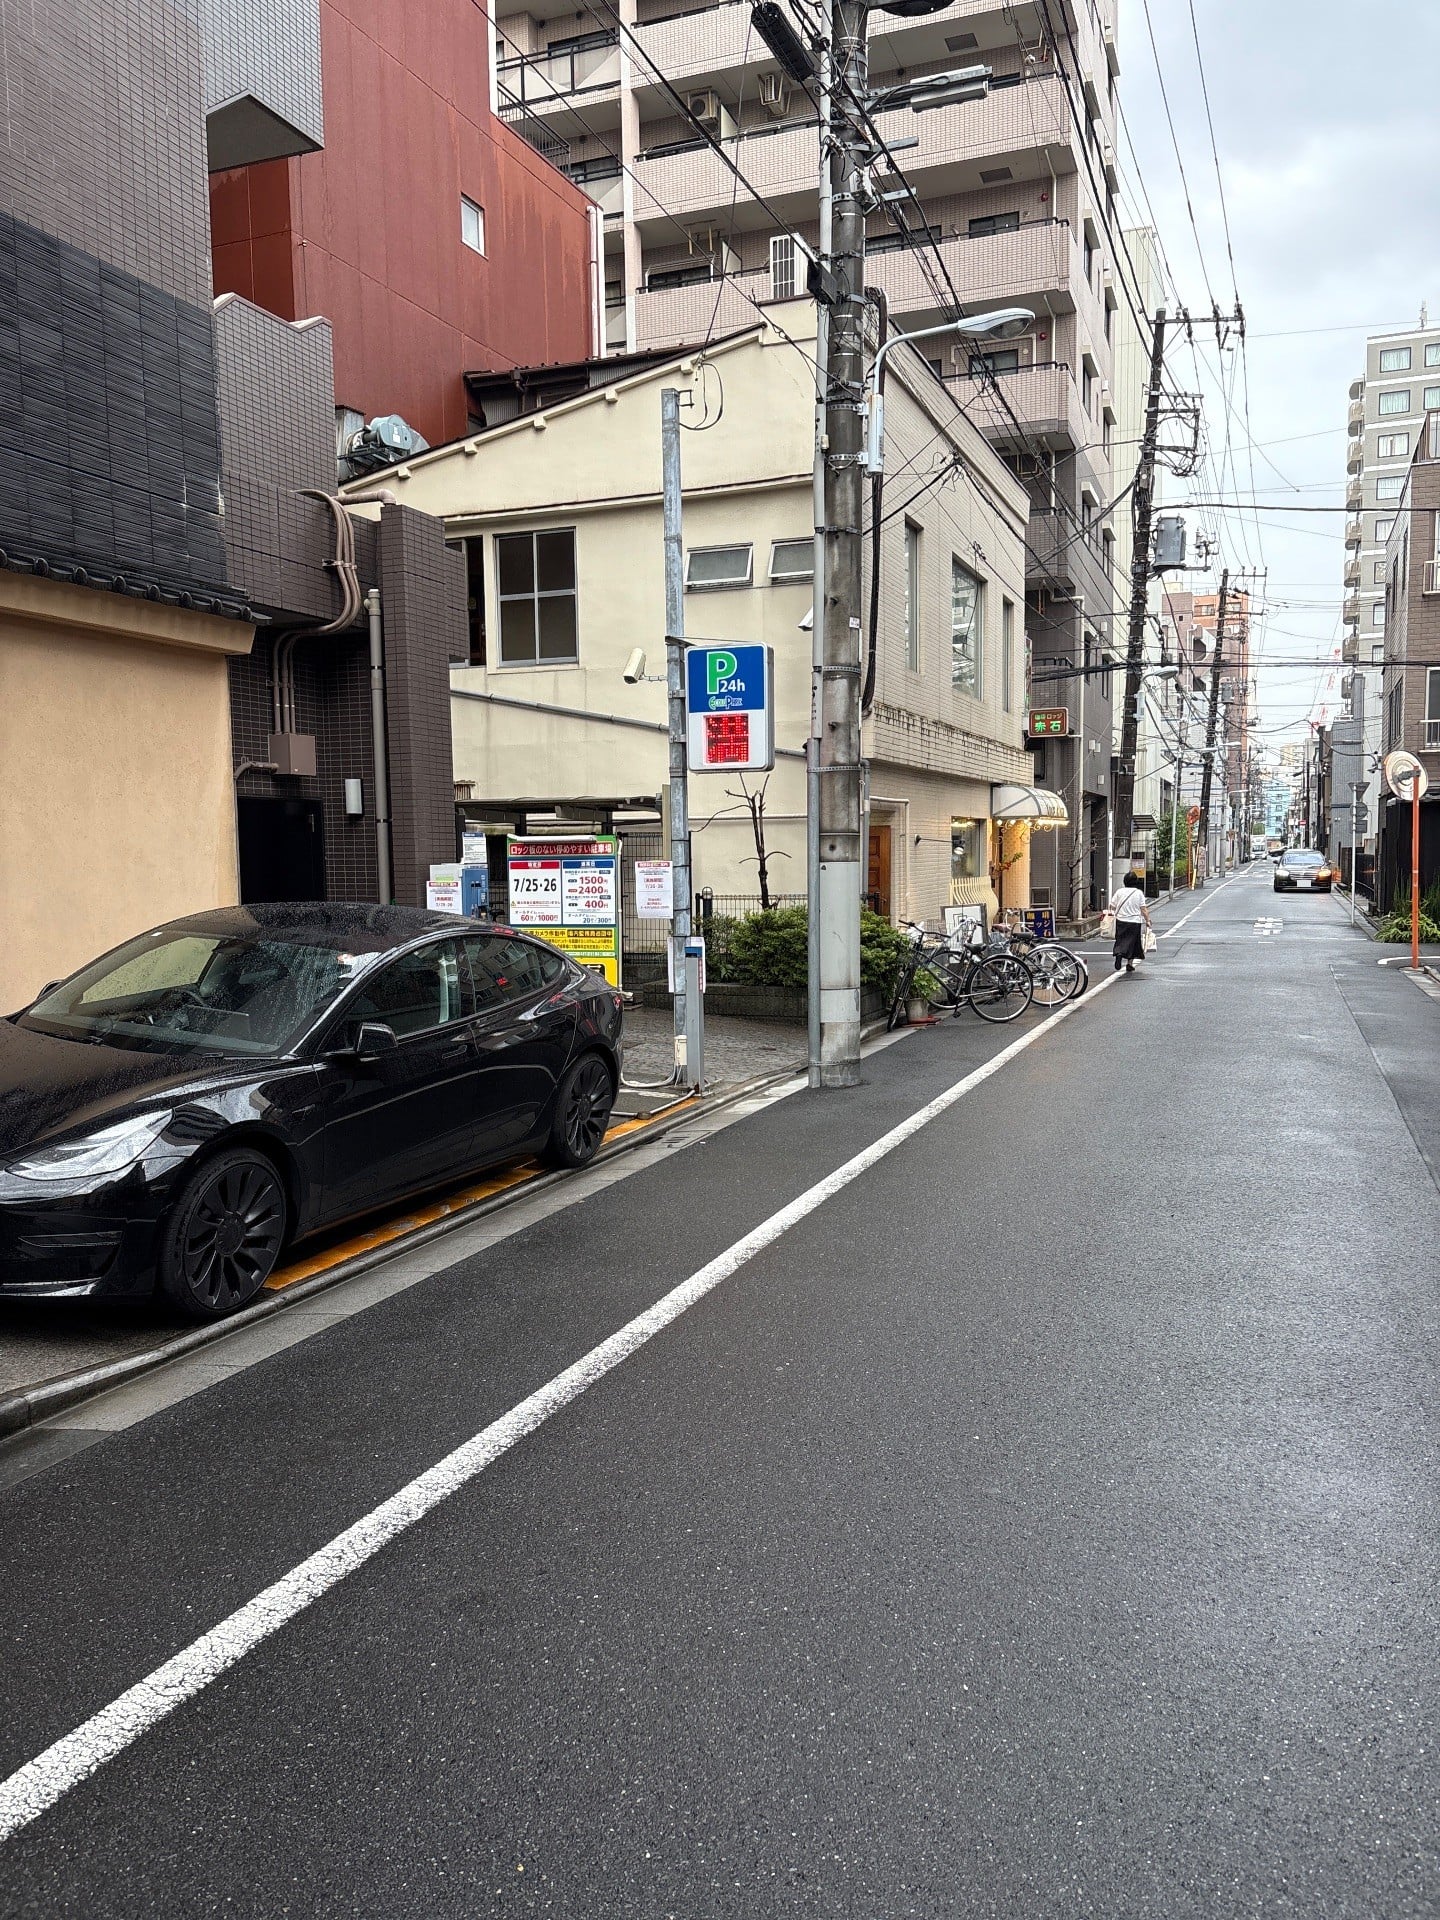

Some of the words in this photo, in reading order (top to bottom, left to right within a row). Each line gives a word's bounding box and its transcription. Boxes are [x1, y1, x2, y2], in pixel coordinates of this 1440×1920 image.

[706, 650, 738, 695] P
[719, 678, 746, 693] 24h
[1034, 720, 1062, 733] 赤石
[511, 843, 612, 854] ロック板のない停めやすい駐車場
[579, 876, 608, 884] 1500円
[578, 886, 608, 894] 2400円
[584, 900, 609, 908] 400円
